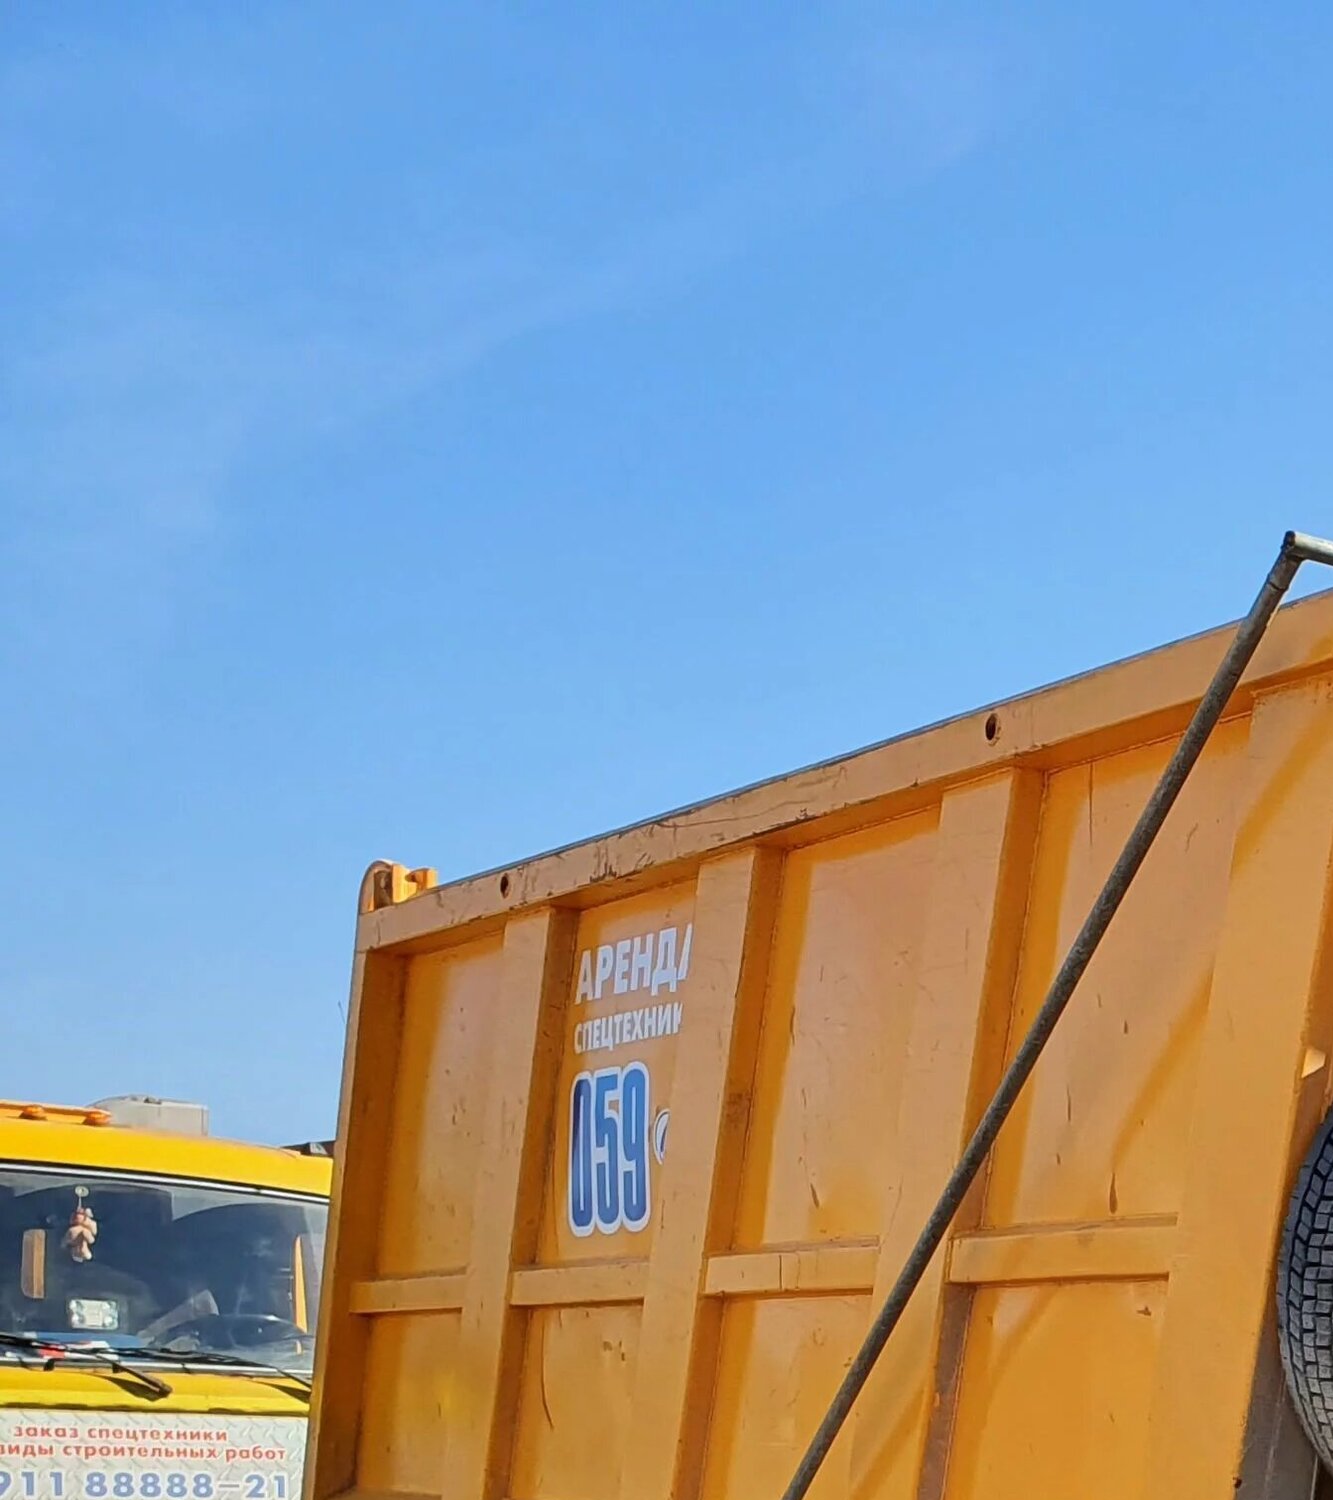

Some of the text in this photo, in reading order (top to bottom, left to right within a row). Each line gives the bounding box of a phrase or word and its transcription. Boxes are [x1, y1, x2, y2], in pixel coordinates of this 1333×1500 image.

[568, 1061, 650, 1237] 059
[14, 1425, 227, 1441] заказ спецтехники
[63, 1445, 217, 1460] строительных
[226, 1446, 285, 1462] работ
[85, 1472, 287, 1499] 88888-21
